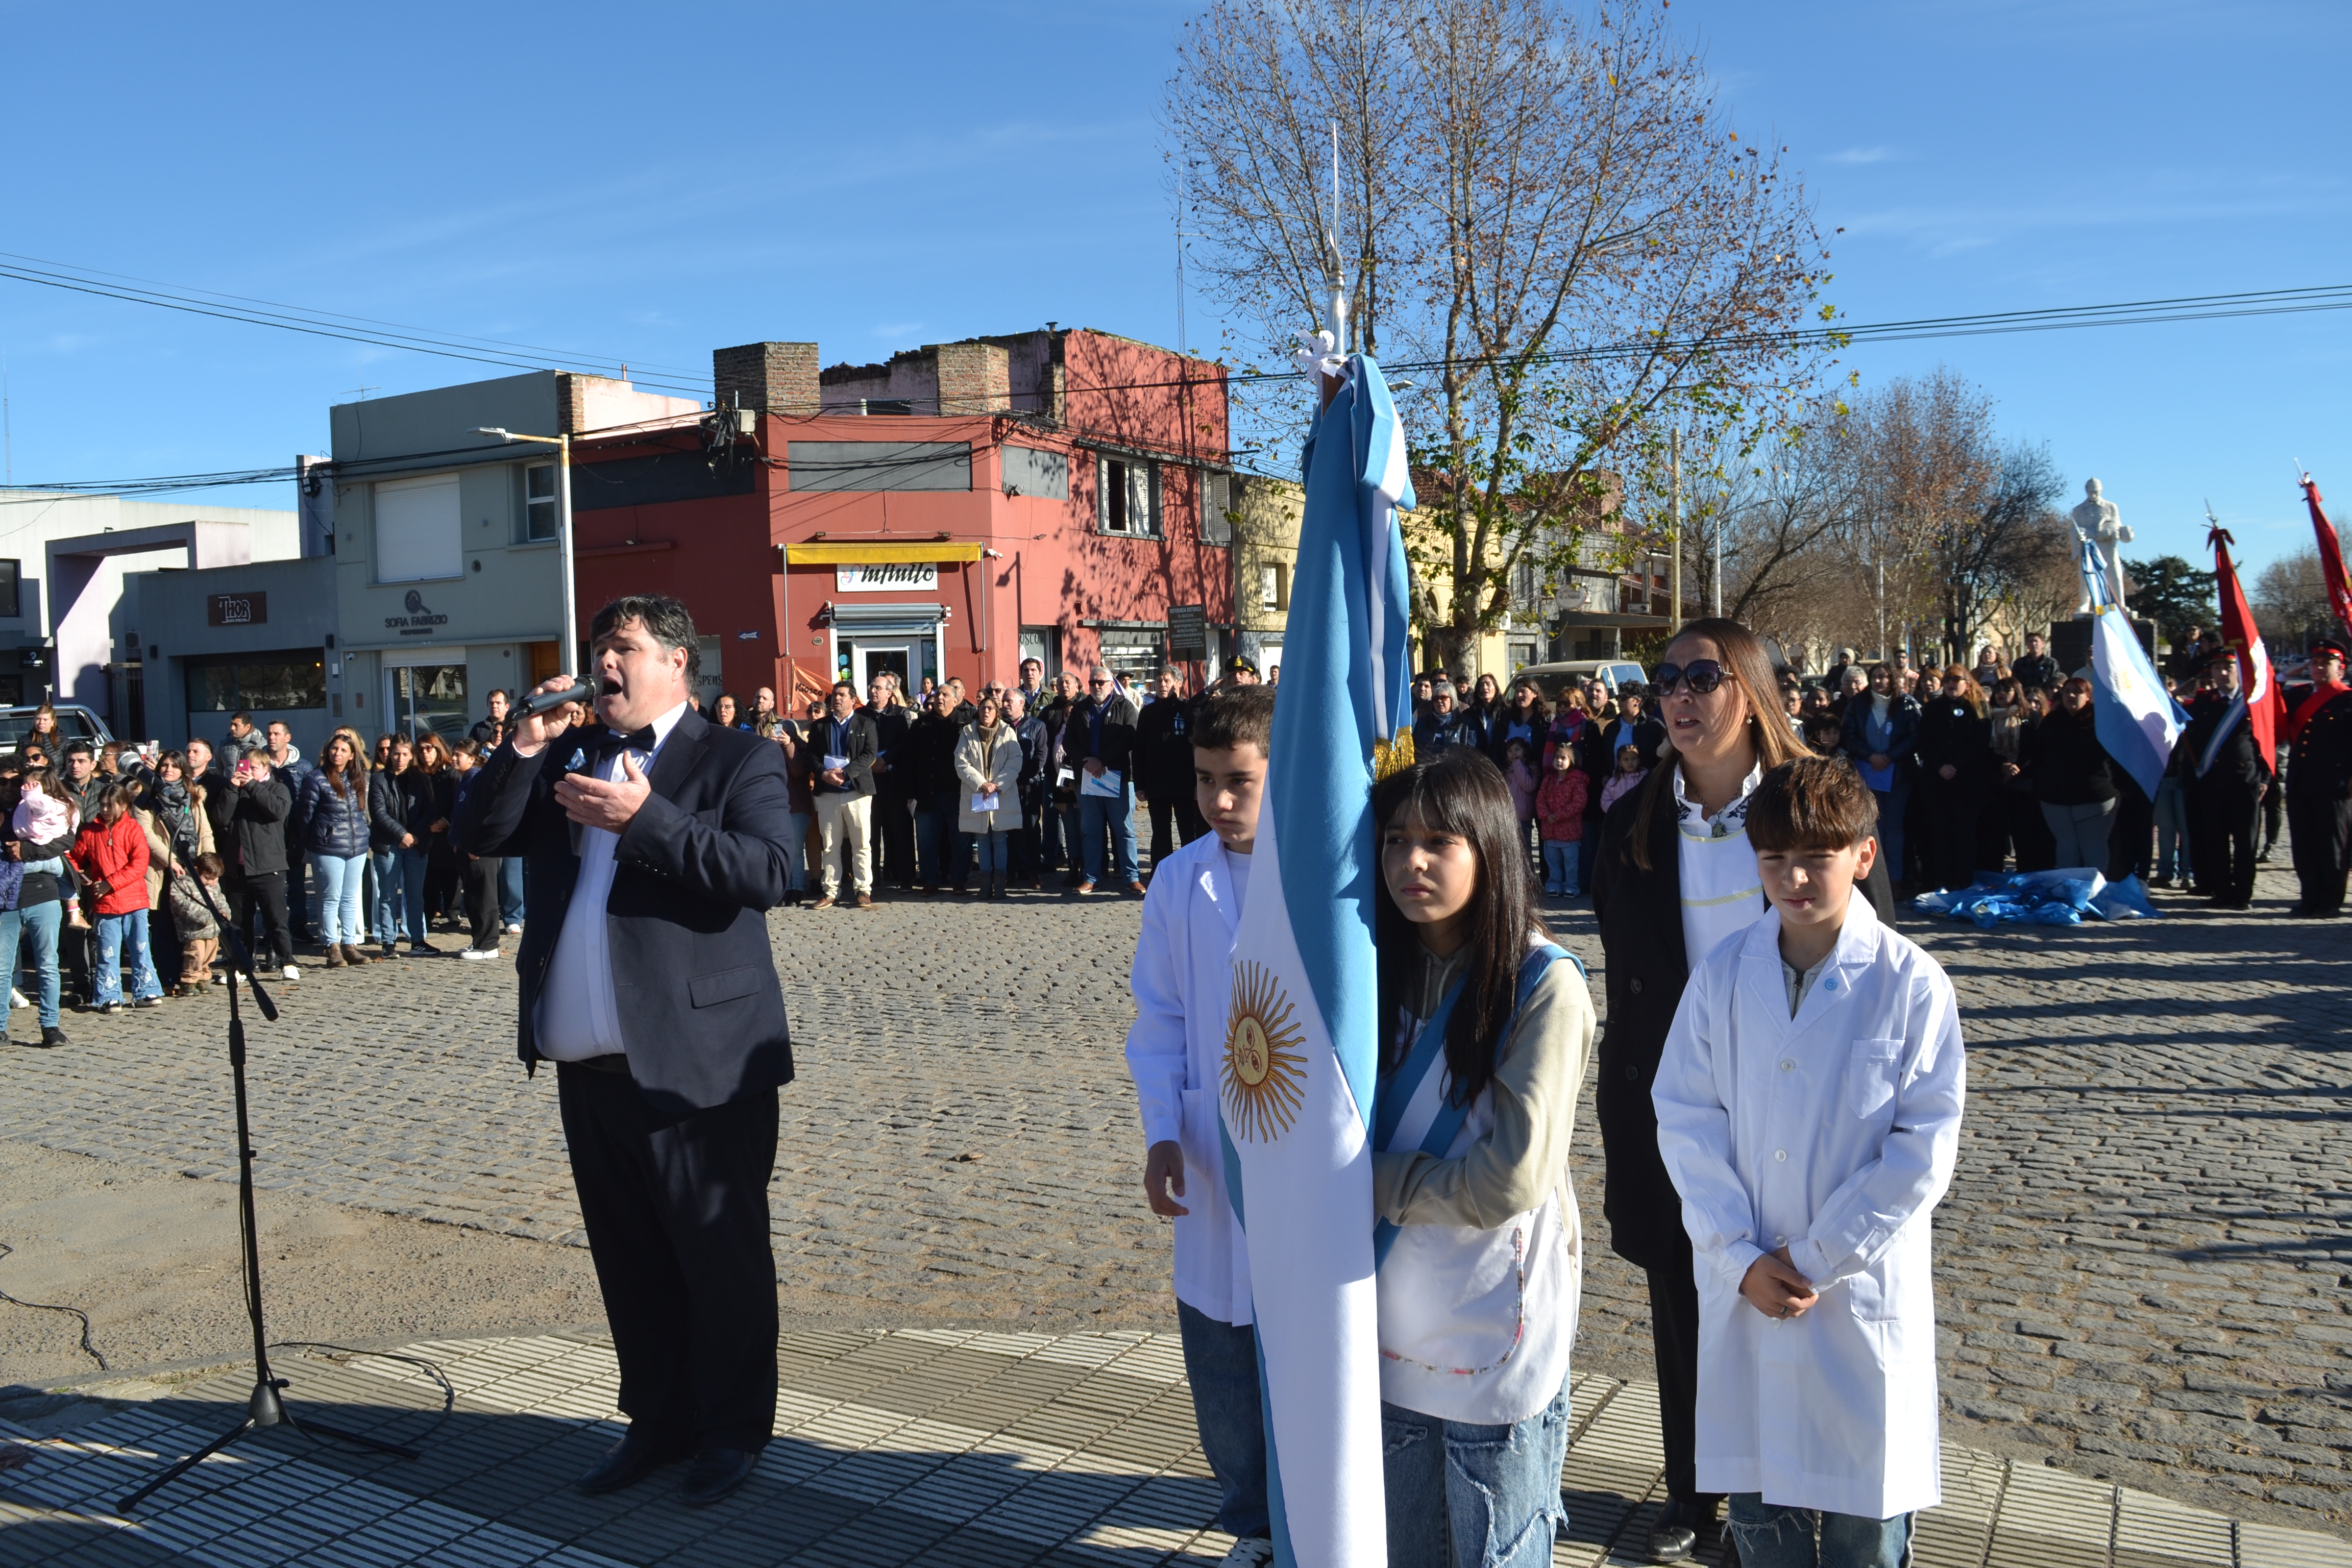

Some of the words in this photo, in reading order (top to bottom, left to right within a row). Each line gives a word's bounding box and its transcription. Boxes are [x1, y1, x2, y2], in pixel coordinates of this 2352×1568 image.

[861, 562, 934, 584] infinito
[385, 617, 409, 628] SOFIA
[411, 614, 448, 626] FABRIZIO
[795, 682, 823, 697] Kiosco
